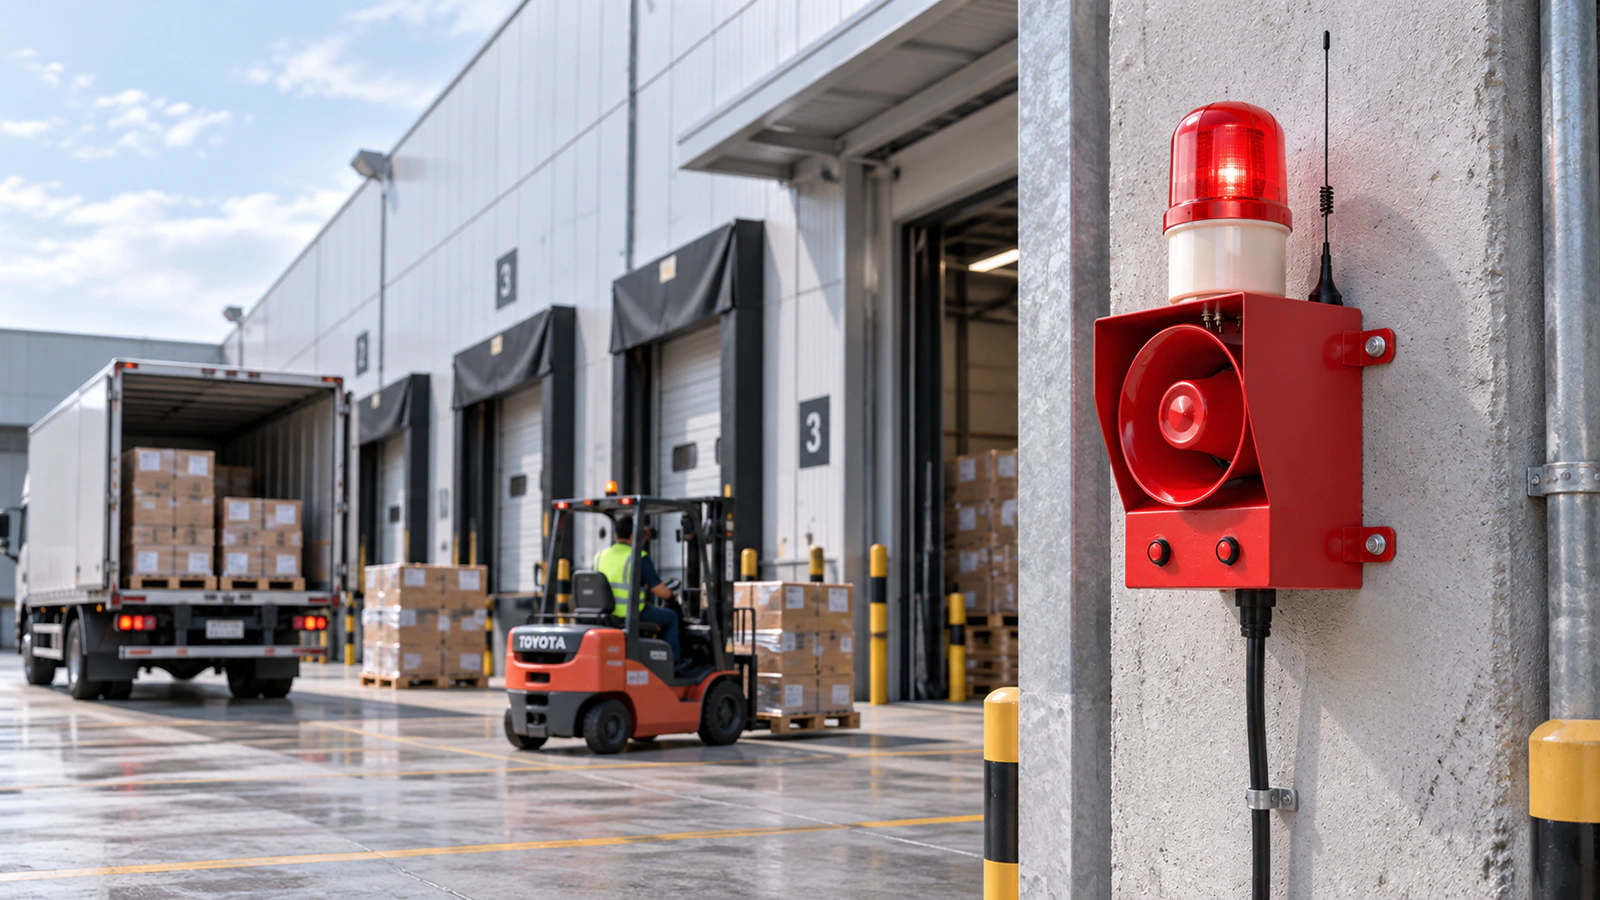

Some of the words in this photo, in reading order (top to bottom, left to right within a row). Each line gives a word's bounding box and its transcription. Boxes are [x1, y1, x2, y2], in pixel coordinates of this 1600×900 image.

[500, 262, 511, 298] 3
[806, 411, 821, 453] 3
[519, 635, 566, 650] TOYOTA
